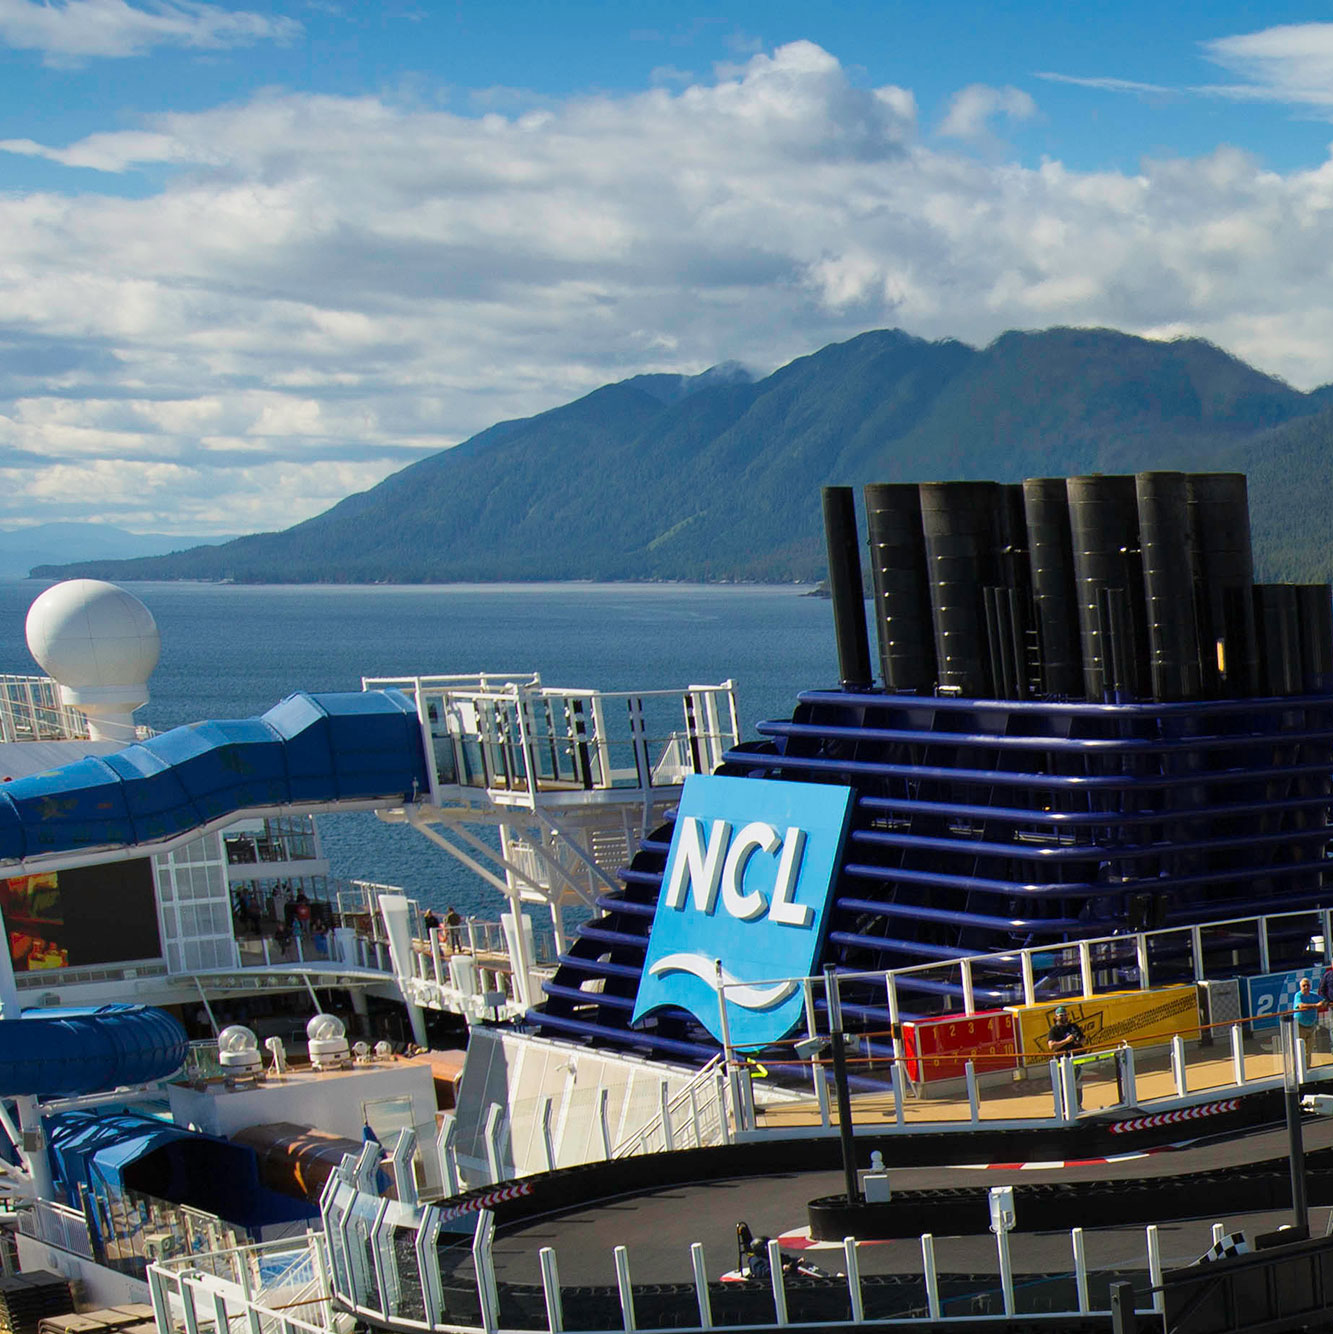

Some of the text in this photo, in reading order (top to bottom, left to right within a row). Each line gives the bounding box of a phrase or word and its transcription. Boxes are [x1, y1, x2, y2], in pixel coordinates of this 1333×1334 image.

[664, 815, 814, 927] NCL
[1257, 994, 1274, 1016] 2
[932, 1016, 1012, 1039] 1 2 3 4 5
[1004, 1044, 1015, 1056] 10
